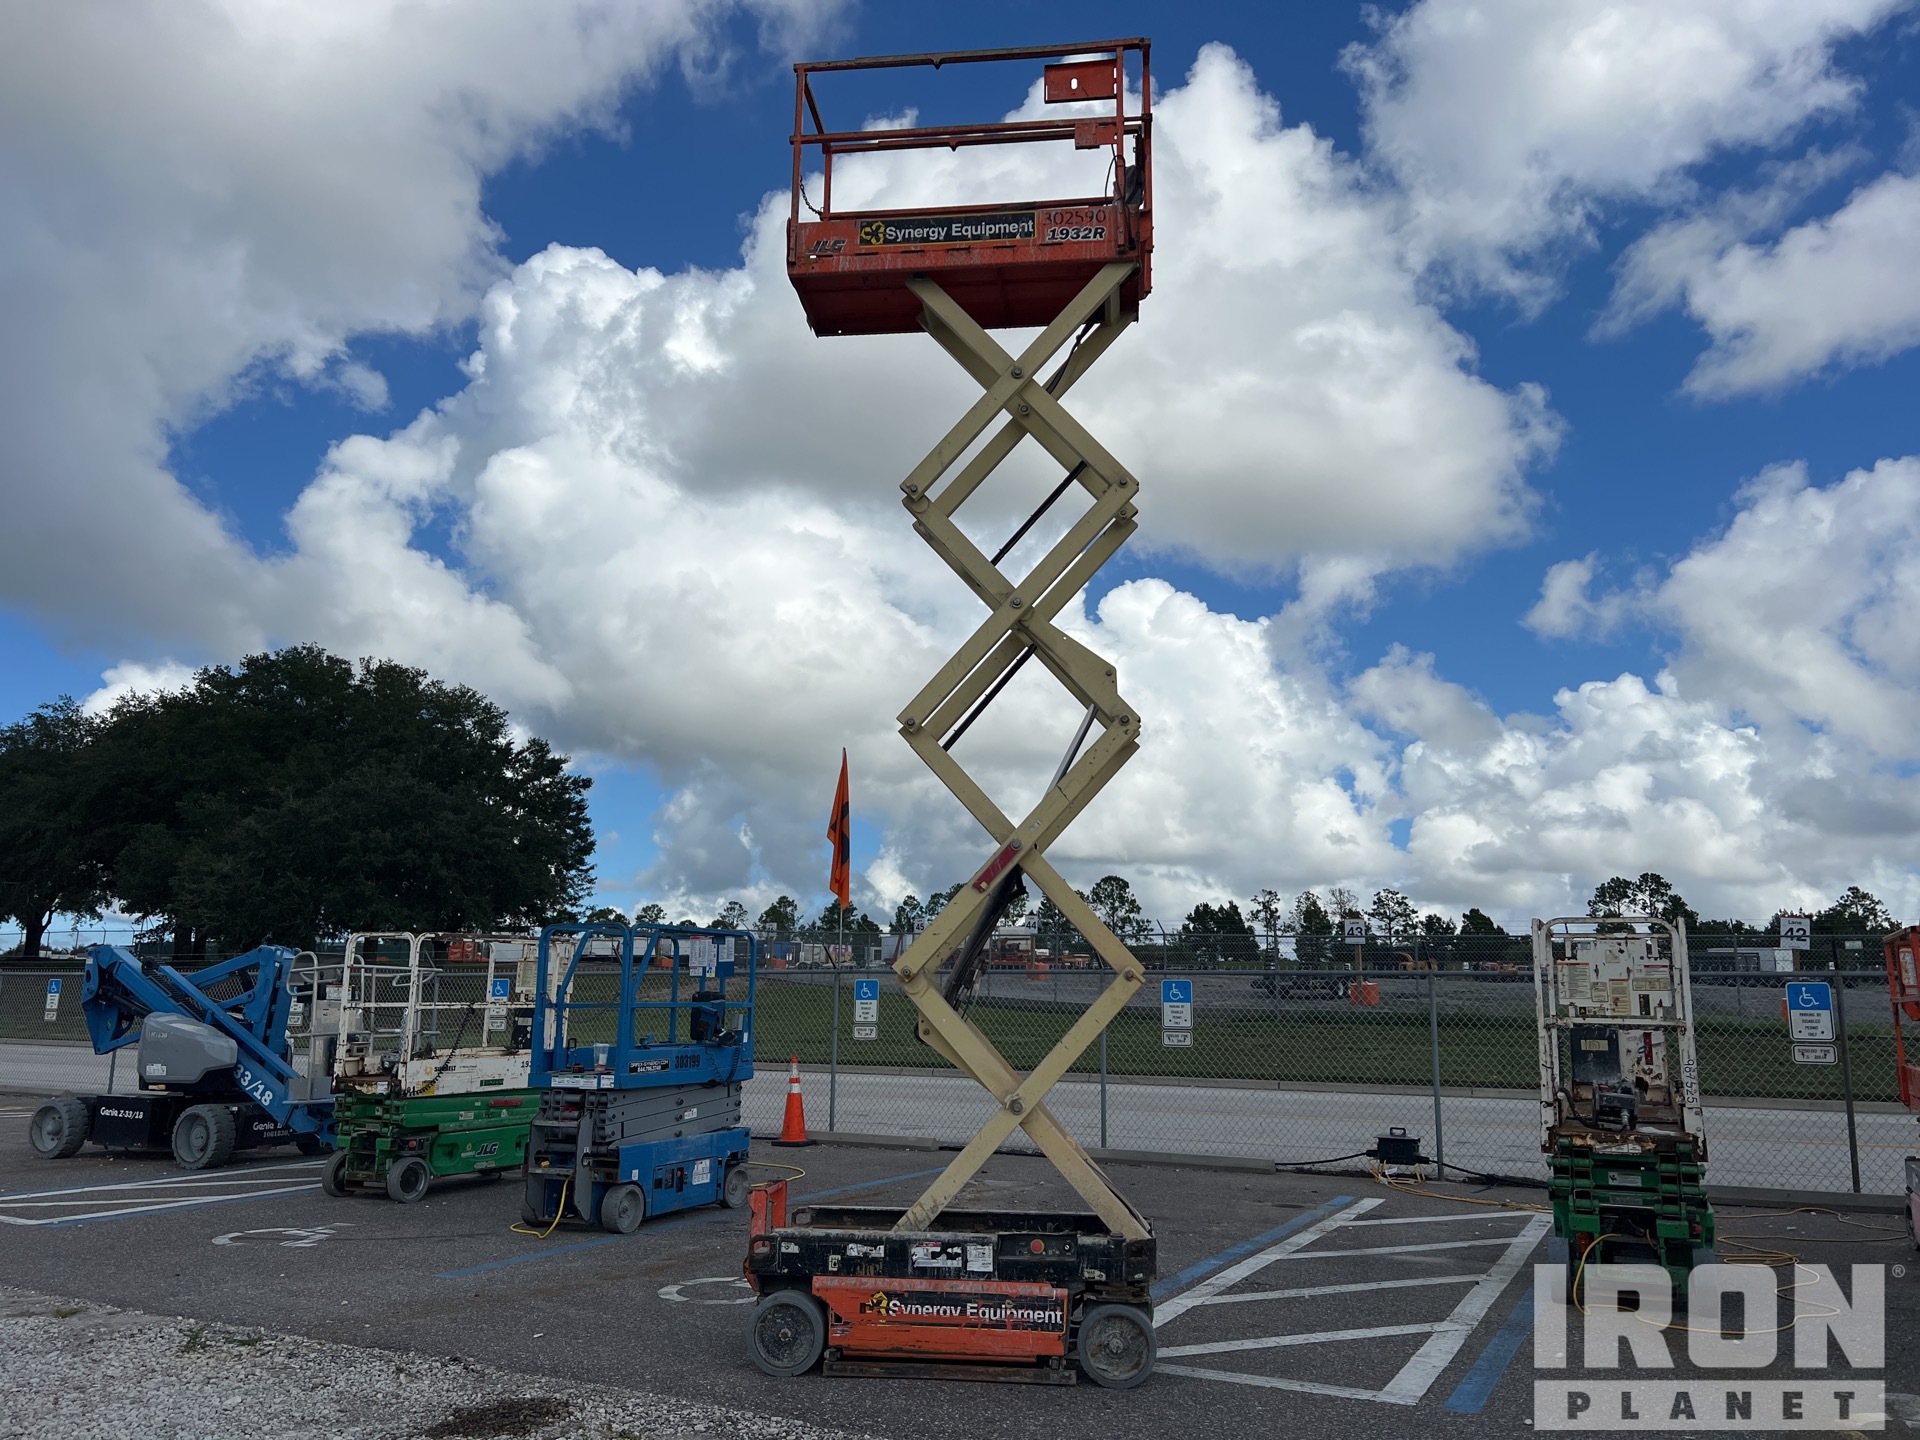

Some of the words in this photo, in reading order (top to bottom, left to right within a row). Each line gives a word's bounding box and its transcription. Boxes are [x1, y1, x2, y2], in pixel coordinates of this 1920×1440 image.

[1043, 210, 1106, 225] 302590
[885, 226, 947, 242] Synergy
[951, 219, 1034, 238] Equipment
[1046, 226, 1106, 241] 1932R
[806, 239, 848, 255] JLG
[915, 922, 925, 931] 45
[1026, 921, 1037, 930] 44
[1347, 926, 1363, 938] 43
[1783, 927, 1807, 942] 42
[675, 1054, 701, 1069] 303199
[233, 1063, 273, 1106] 33/18
[100, 1106, 118, 1117] Genie
[119, 1109, 144, 1119] Z-33/18
[252, 1121, 275, 1131] Genie
[475, 1141, 499, 1157] JLG
